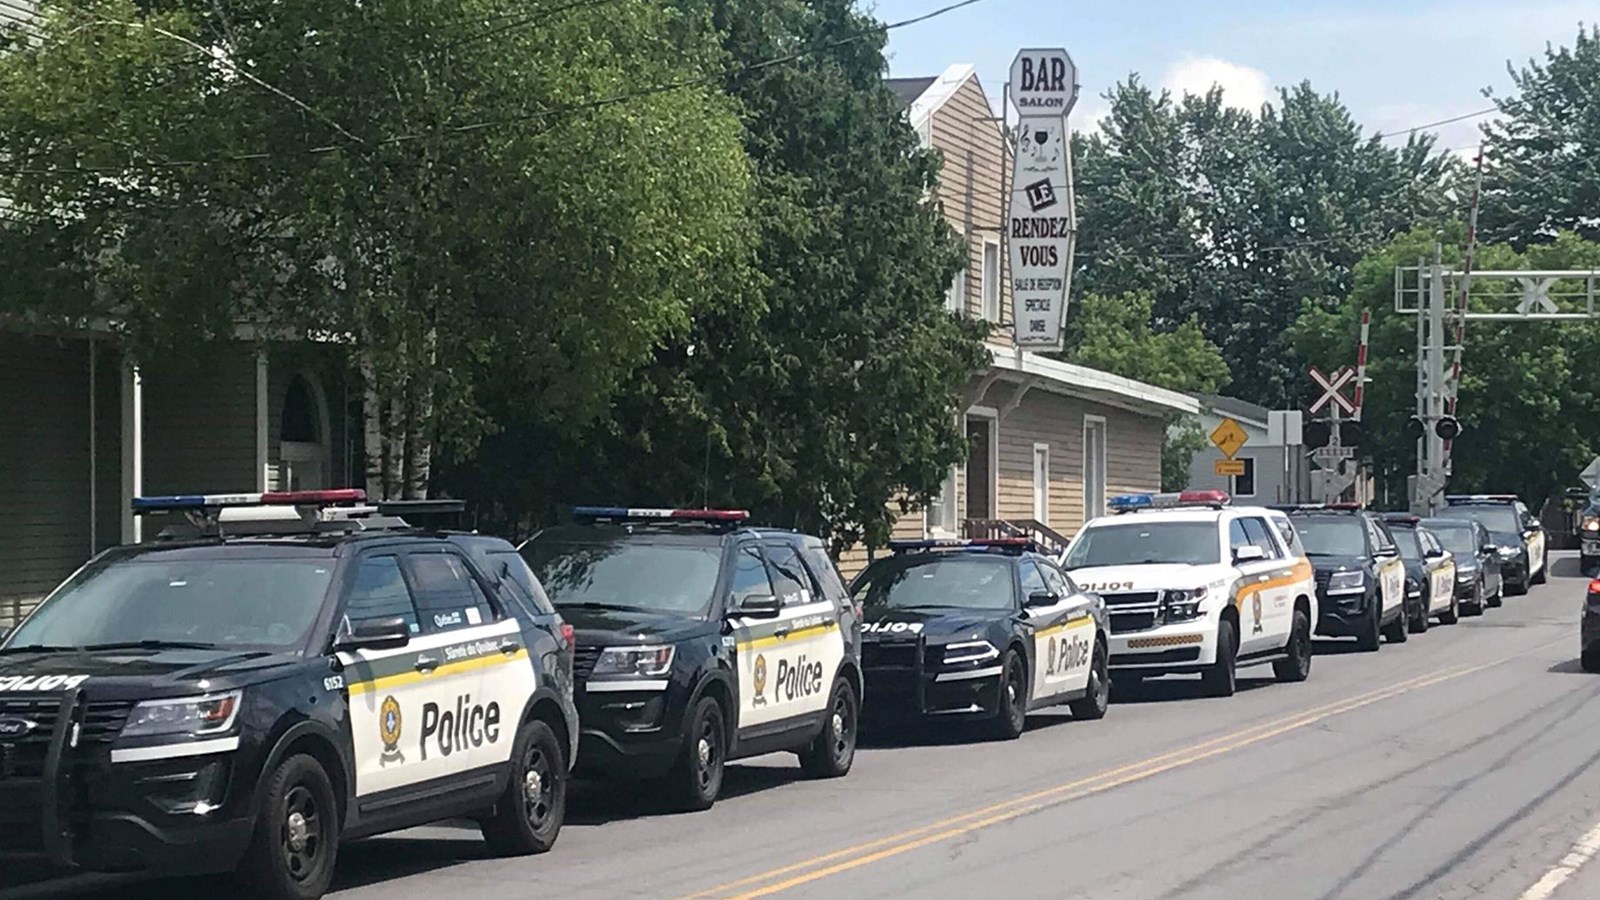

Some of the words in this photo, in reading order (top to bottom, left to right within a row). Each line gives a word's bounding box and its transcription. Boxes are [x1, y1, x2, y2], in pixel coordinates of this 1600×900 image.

[1020, 57, 1065, 91] BAR
[1019, 97, 1063, 107] SALON
[1029, 183, 1053, 206] LE
[1012, 217, 1068, 238] RENDEZ
[1020, 245, 1058, 267] VOUS
[1057, 633, 1089, 673] Police
[323, 675, 344, 691] 6152
[775, 654, 823, 703] Police
[420, 694, 500, 761] Police
